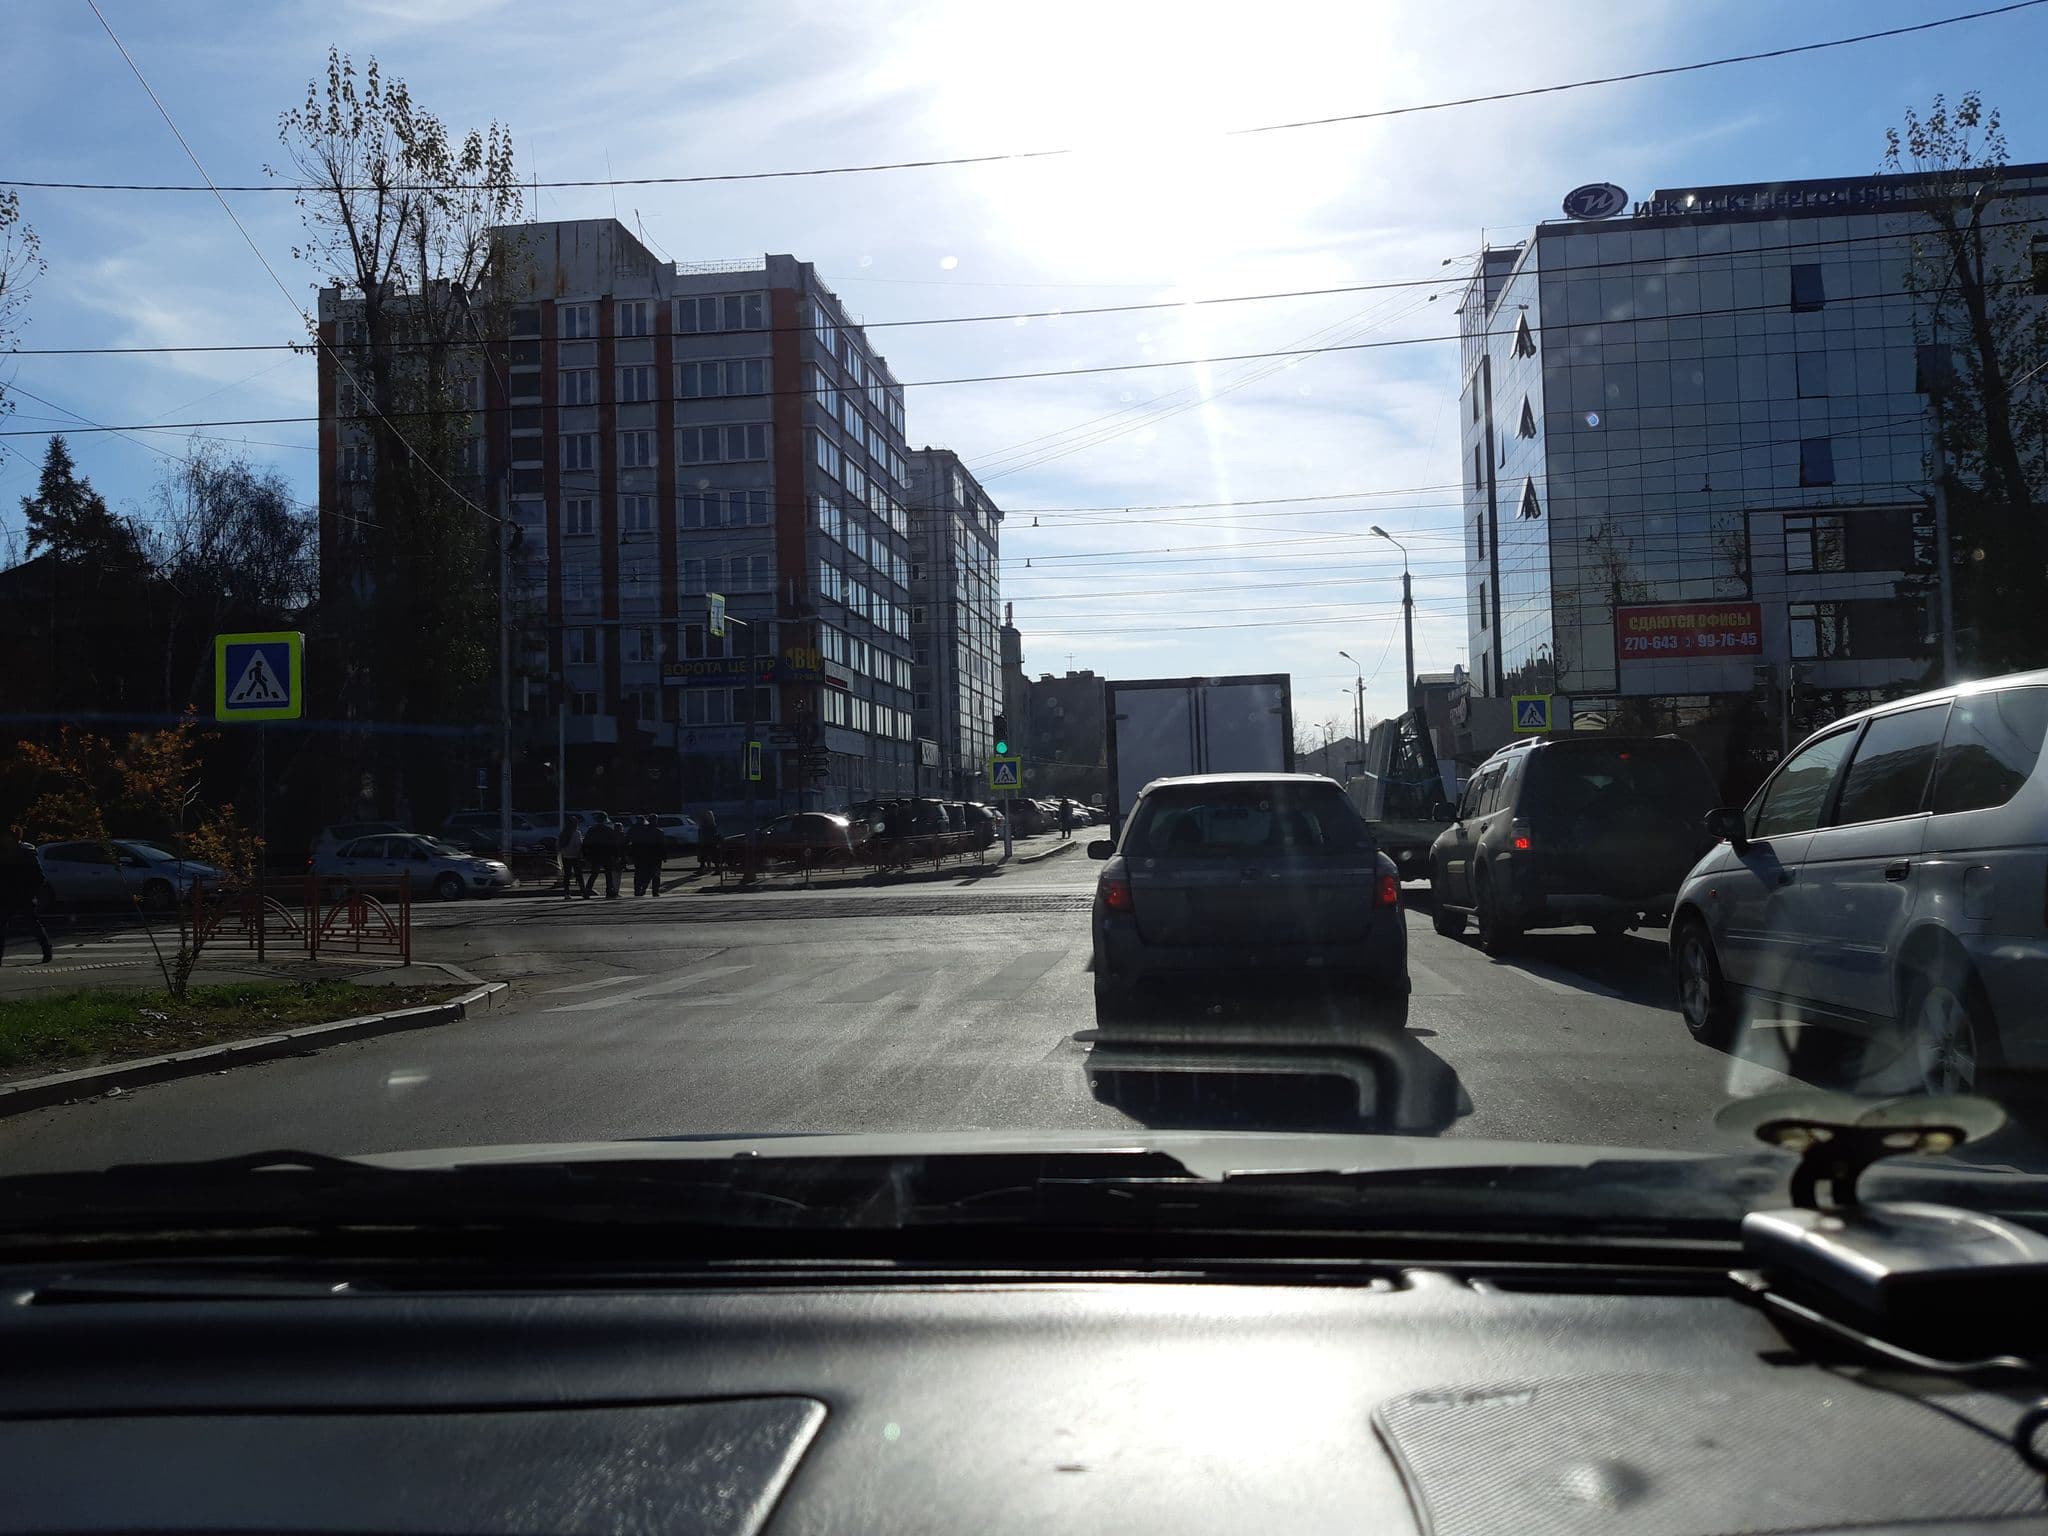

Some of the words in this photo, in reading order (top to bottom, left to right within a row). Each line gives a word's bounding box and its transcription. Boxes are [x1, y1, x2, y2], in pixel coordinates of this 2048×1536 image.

[1628, 614, 1695, 632] СДАЮТСЯ
[1697, 612, 1752, 628] ОФИСЫ
[1624, 635, 1679, 652] 270-643
[1697, 632, 1758, 649] 99-76-45
